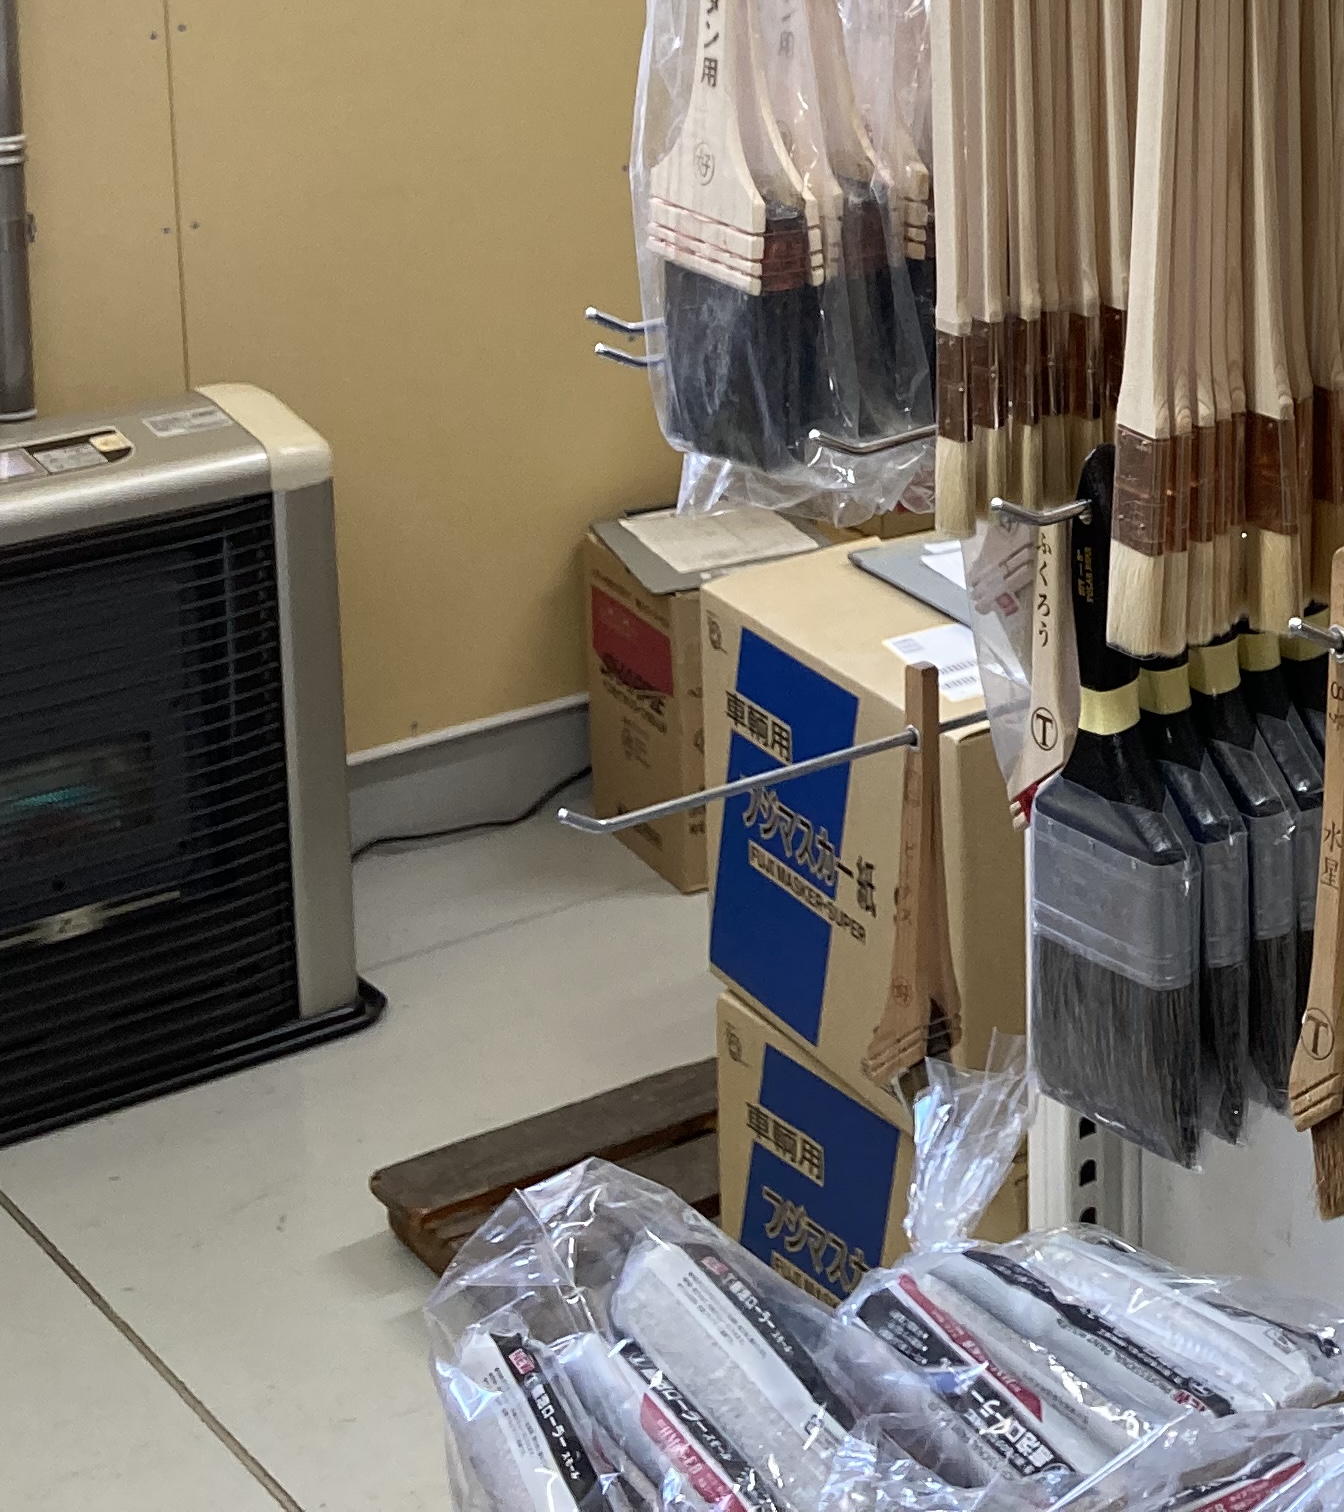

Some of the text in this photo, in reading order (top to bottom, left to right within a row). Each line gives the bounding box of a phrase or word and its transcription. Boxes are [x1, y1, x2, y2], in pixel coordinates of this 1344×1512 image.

[1036, 532, 1052, 648] ふくろう
[1034, 710, 1056, 750] T
[1320, 821, 1344, 890] 水星
[1303, 1011, 1332, 1058] T
